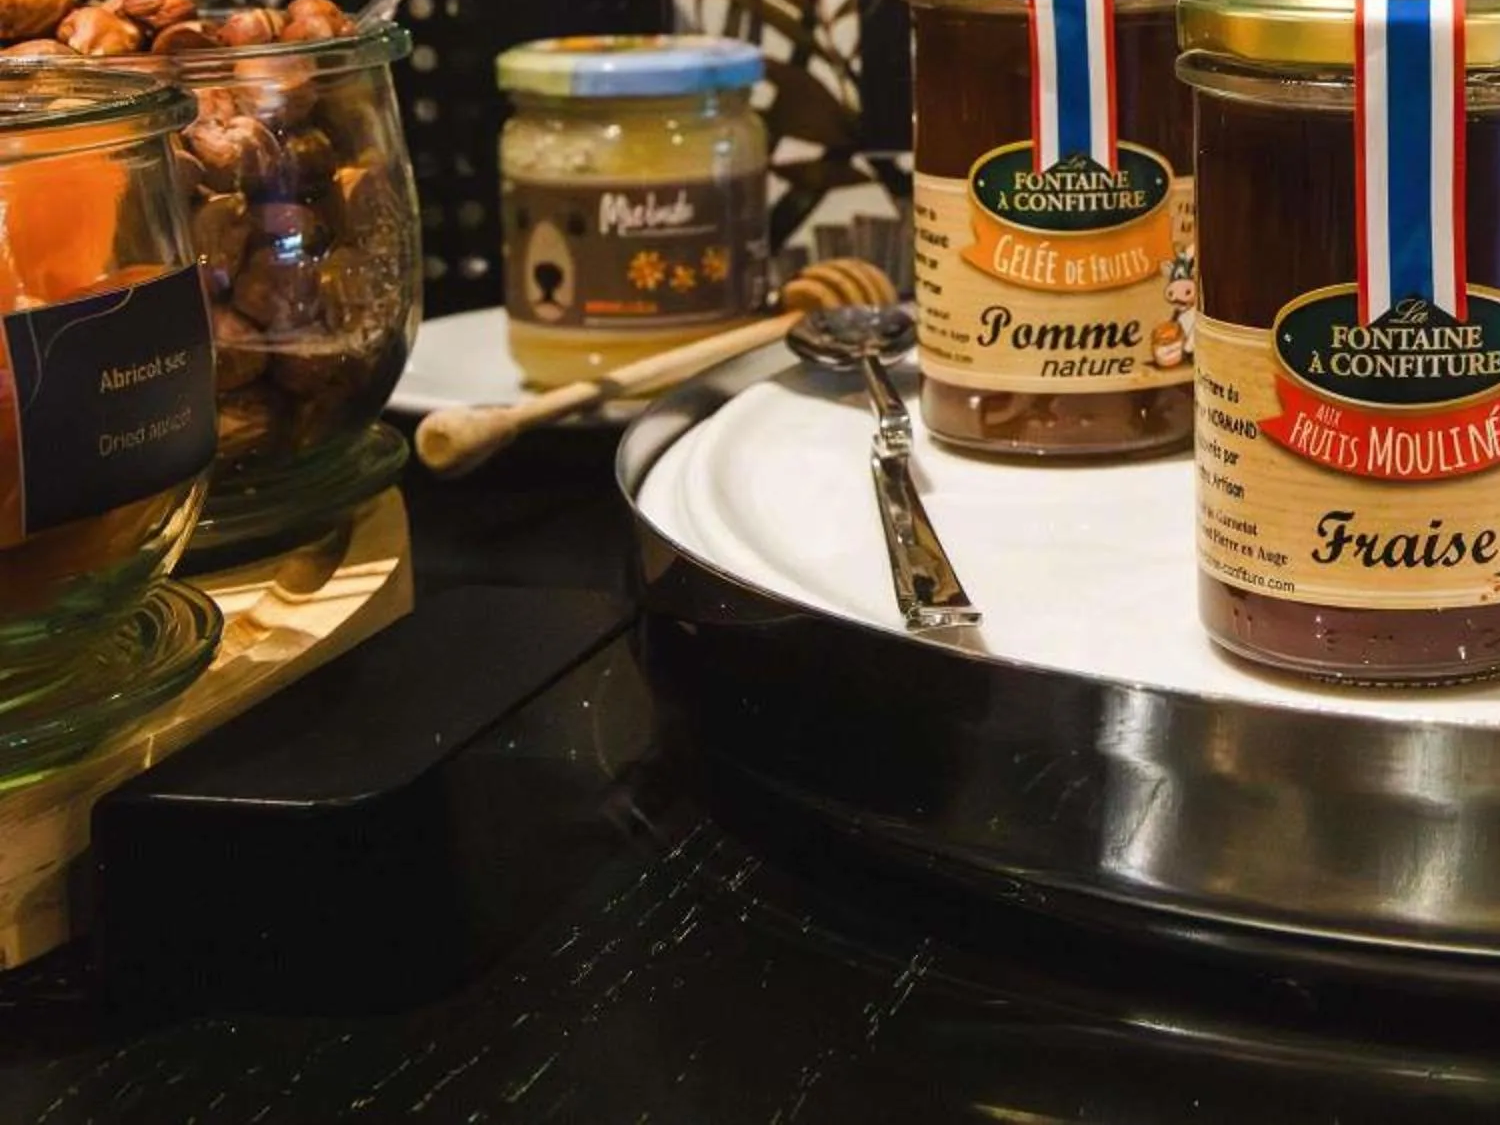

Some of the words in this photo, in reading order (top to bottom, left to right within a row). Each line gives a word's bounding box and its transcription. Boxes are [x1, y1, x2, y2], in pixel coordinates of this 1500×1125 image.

[1013, 170, 1130, 192] FONTAINE
[1013, 190, 1147, 213] CONFITURE
[992, 234, 1061, 285] GELÉE
[1064, 258, 1087, 286] DE
[1089, 247, 1149, 284] FRUITS
[1388, 298, 1430, 325] La
[977, 304, 1143, 351] Pomme
[1330, 325, 1484, 351] FONTAINE
[100, 355, 162, 394] Abricot
[1040, 356, 1135, 378] nature
[1308, 349, 1325, 375] À
[1316, 403, 1342, 427] AUX
[100, 427, 145, 457] Dried
[1289, 411, 1360, 470] FRUITS
[1311, 509, 1500, 570] Fraise
